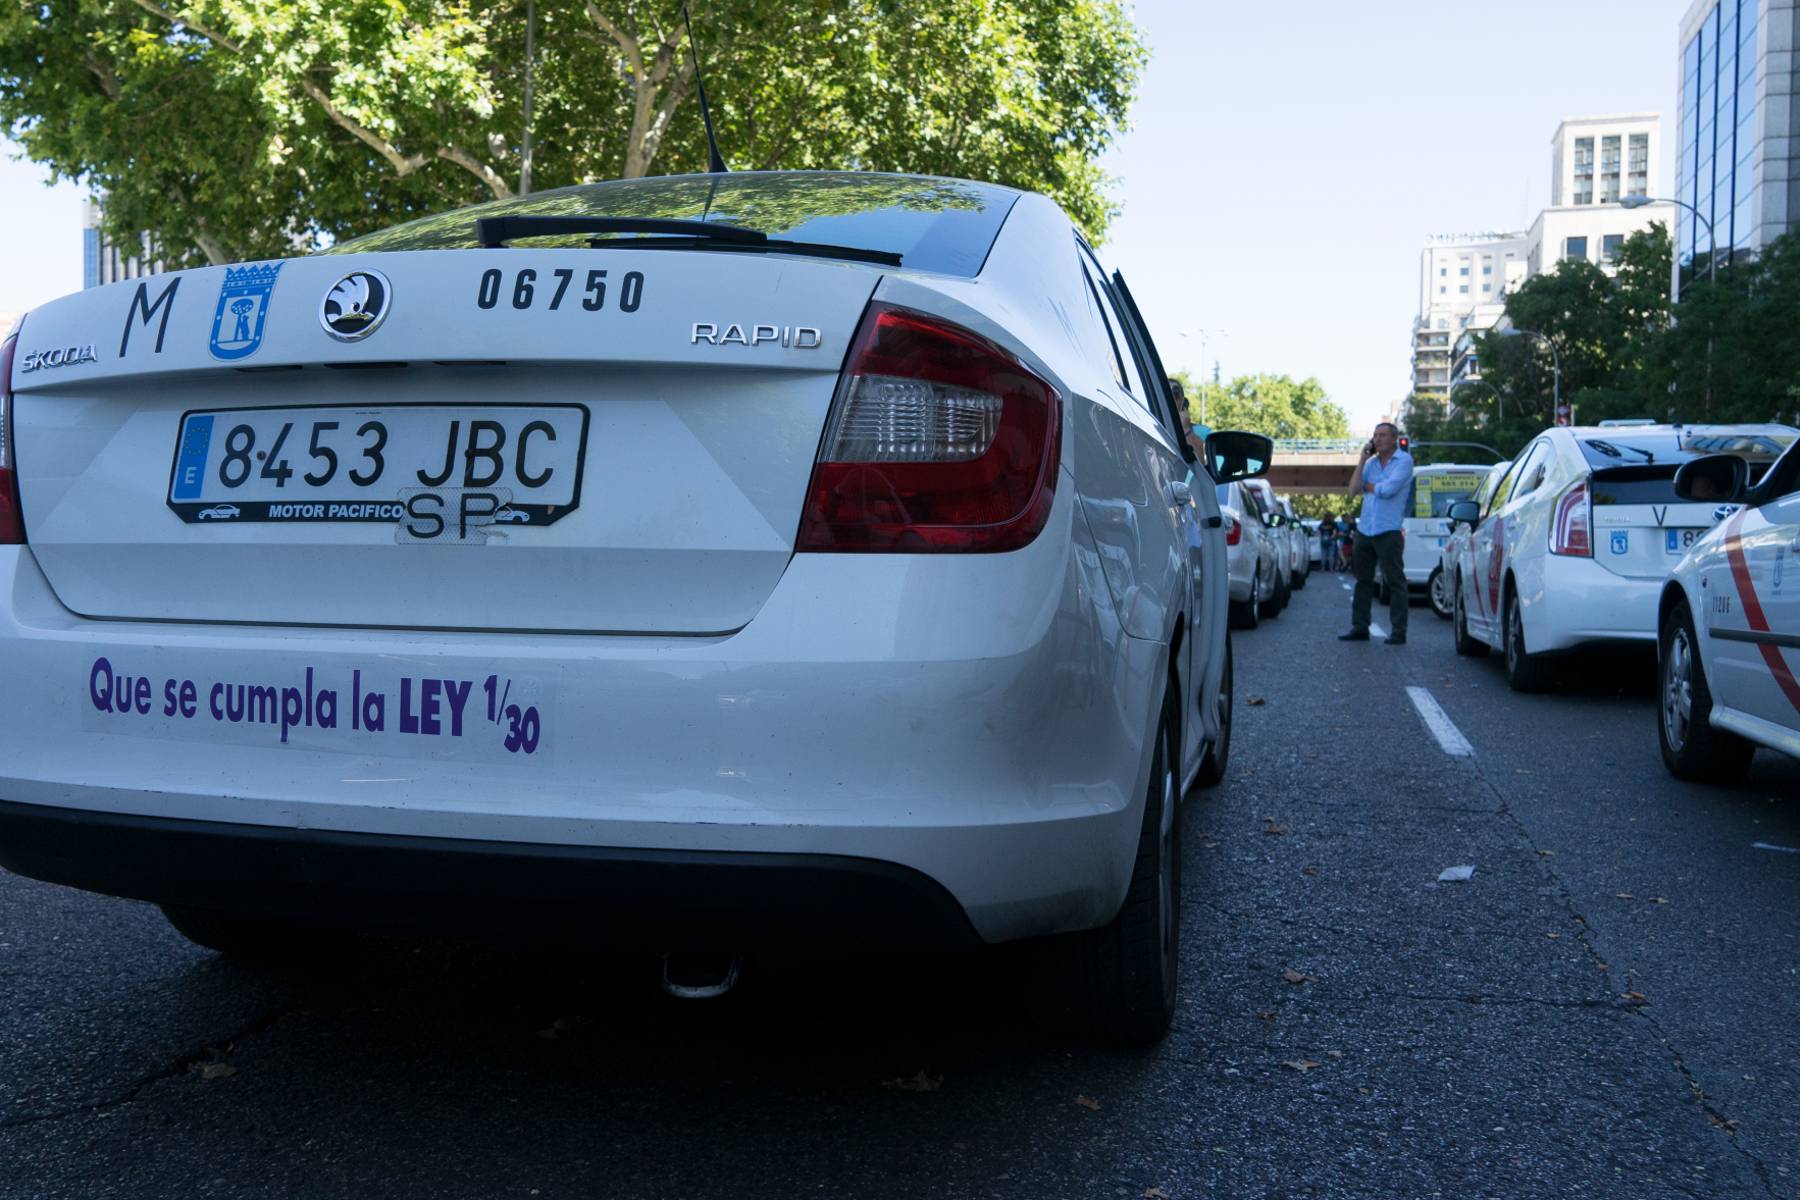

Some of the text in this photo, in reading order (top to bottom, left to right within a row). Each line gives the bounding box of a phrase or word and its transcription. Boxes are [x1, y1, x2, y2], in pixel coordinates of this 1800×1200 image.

[477, 268, 645, 313] 06750
[119, 276, 182, 358] M
[690, 322, 822, 349] RAPID
[184, 466, 197, 485] E
[218, 420, 557, 489] 8453 JBC
[268, 504, 403, 519] MOTOR PACIFICO
[407, 492, 497, 539] SP
[1652, 505, 1667, 528] V
[89, 656, 541, 755] Que se cumpla la LEY 1/30
